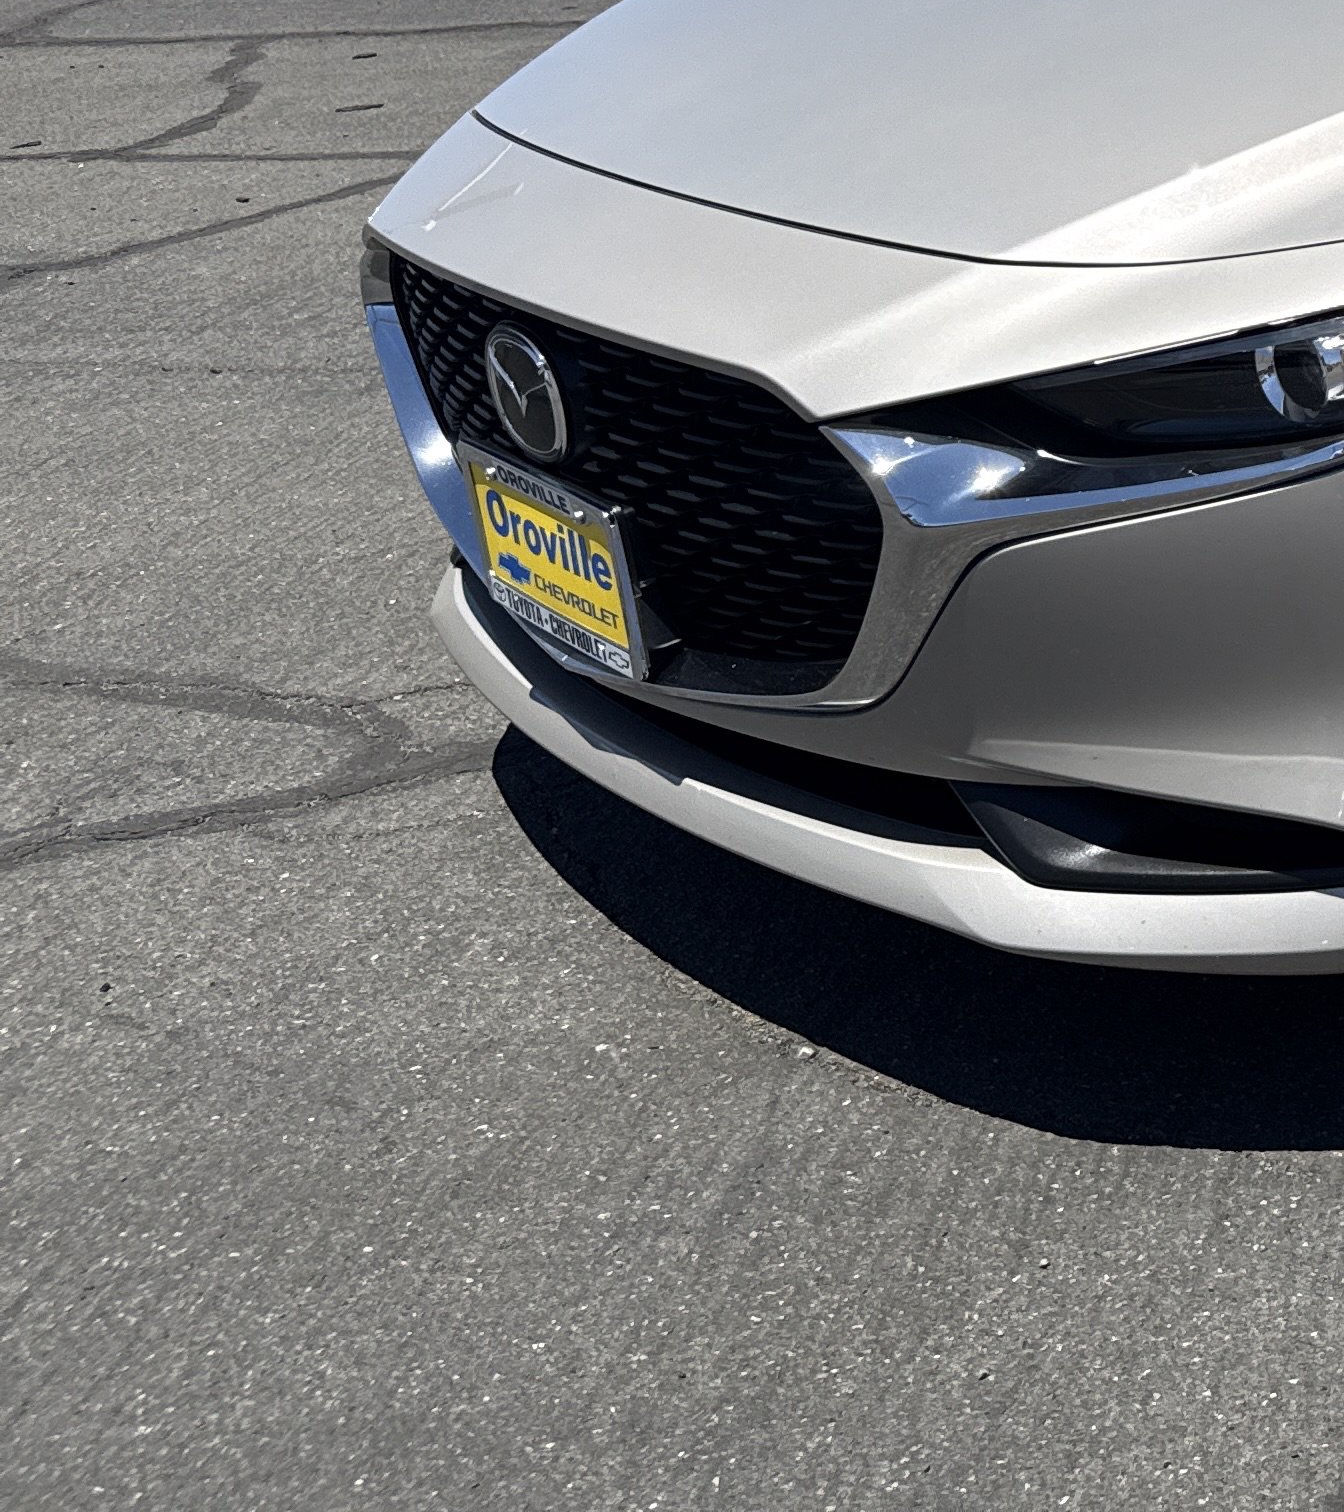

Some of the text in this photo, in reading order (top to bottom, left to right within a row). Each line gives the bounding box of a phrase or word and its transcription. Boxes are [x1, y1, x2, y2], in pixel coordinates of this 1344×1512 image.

[496, 464, 571, 515] OROVILLE
[486, 489, 613, 591] Oroville
[506, 588, 608, 663] TOYOTA CHEVROLET
[534, 573, 619, 629] CHEVROLET
